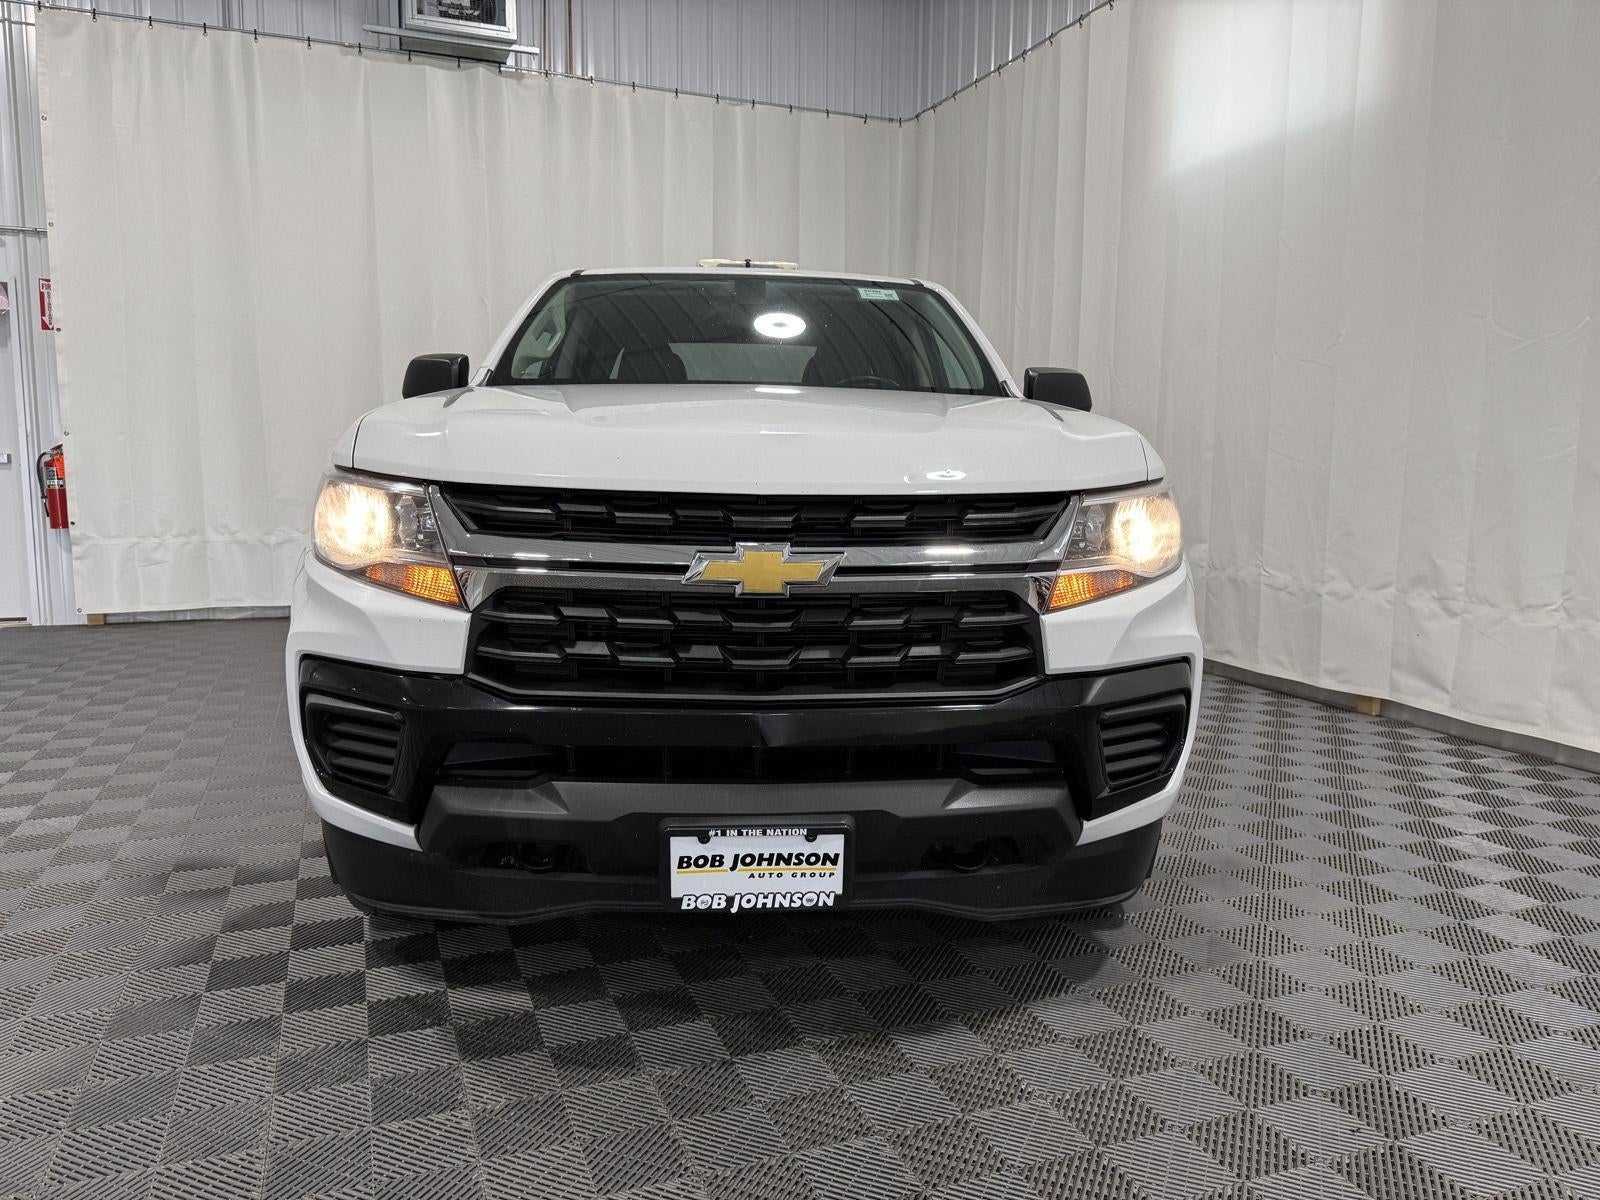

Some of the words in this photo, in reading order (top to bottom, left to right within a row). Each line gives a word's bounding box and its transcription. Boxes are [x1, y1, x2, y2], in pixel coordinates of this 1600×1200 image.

[708, 829, 722, 837] #1
[726, 829, 738, 837] IN
[741, 829, 763, 837] THE
[766, 828, 808, 837] NATION
[677, 854, 725, 870] BOB
[729, 852, 840, 872] JOHNSON
[681, 893, 727, 910] BOB
[730, 891, 836, 914] JOHNSON
